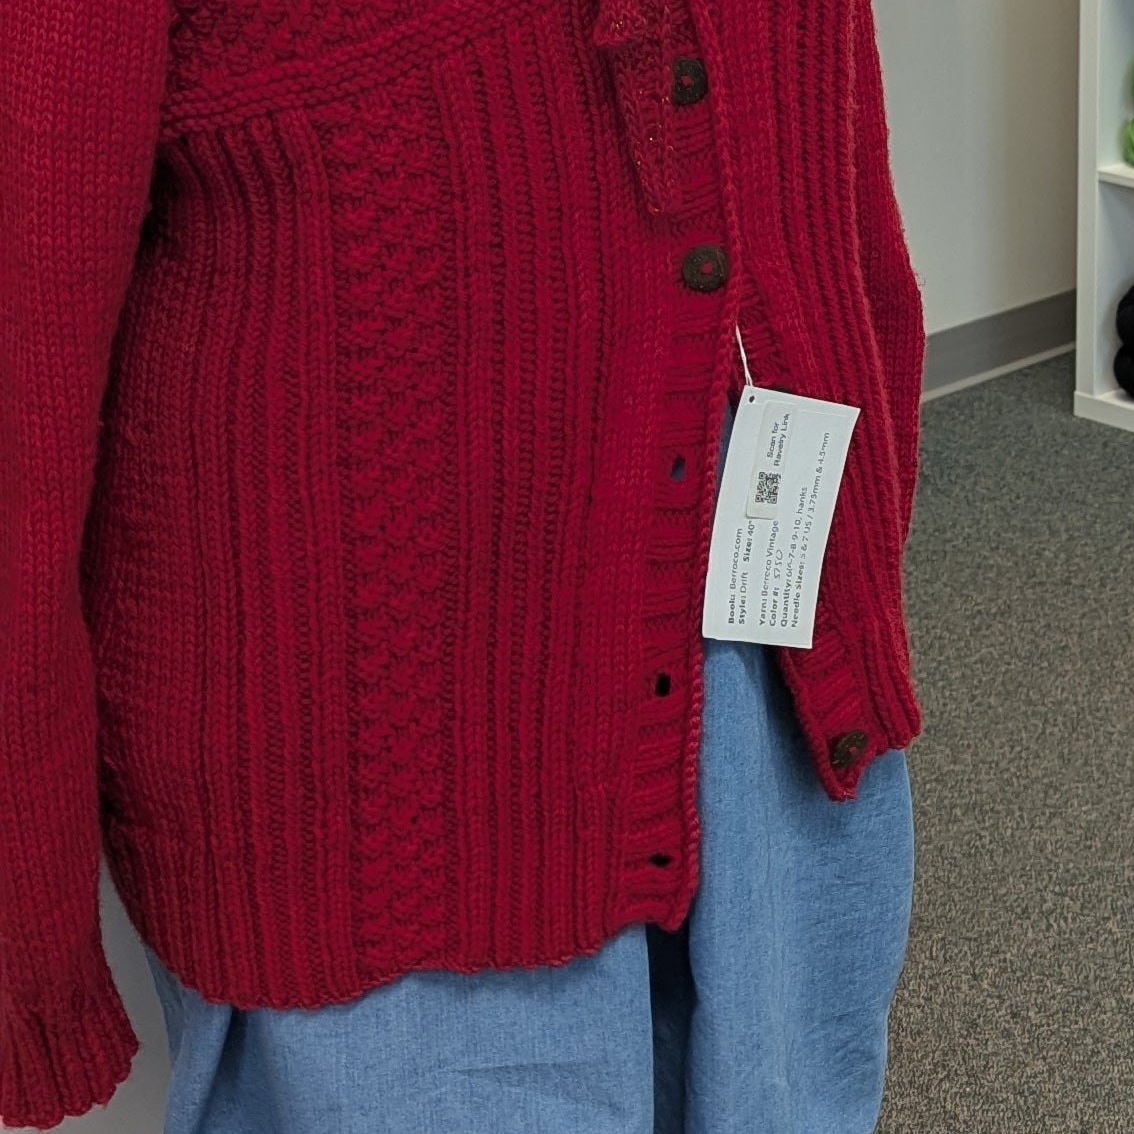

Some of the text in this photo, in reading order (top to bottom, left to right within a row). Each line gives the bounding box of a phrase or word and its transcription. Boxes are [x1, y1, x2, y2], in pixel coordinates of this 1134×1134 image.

[767, 422, 780, 458] Scan for
[774, 413, 790, 467] Ravelry Link
[816, 466, 823, 474] &
[804, 521, 812, 534] US
[730, 528, 743, 590] Berroco.com
[743, 538, 753, 562] Size:
[781, 579, 792, 627] Quantity:
[796, 487, 808, 515] hanks
[801, 543, 808, 552] &
[740, 572, 749, 594] Drift
[760, 520, 779, 626] Yarn: Berroco Vintage
[739, 595, 747, 625] Style:
[770, 598, 778, 627] Color
[792, 592, 801, 628] Needle
